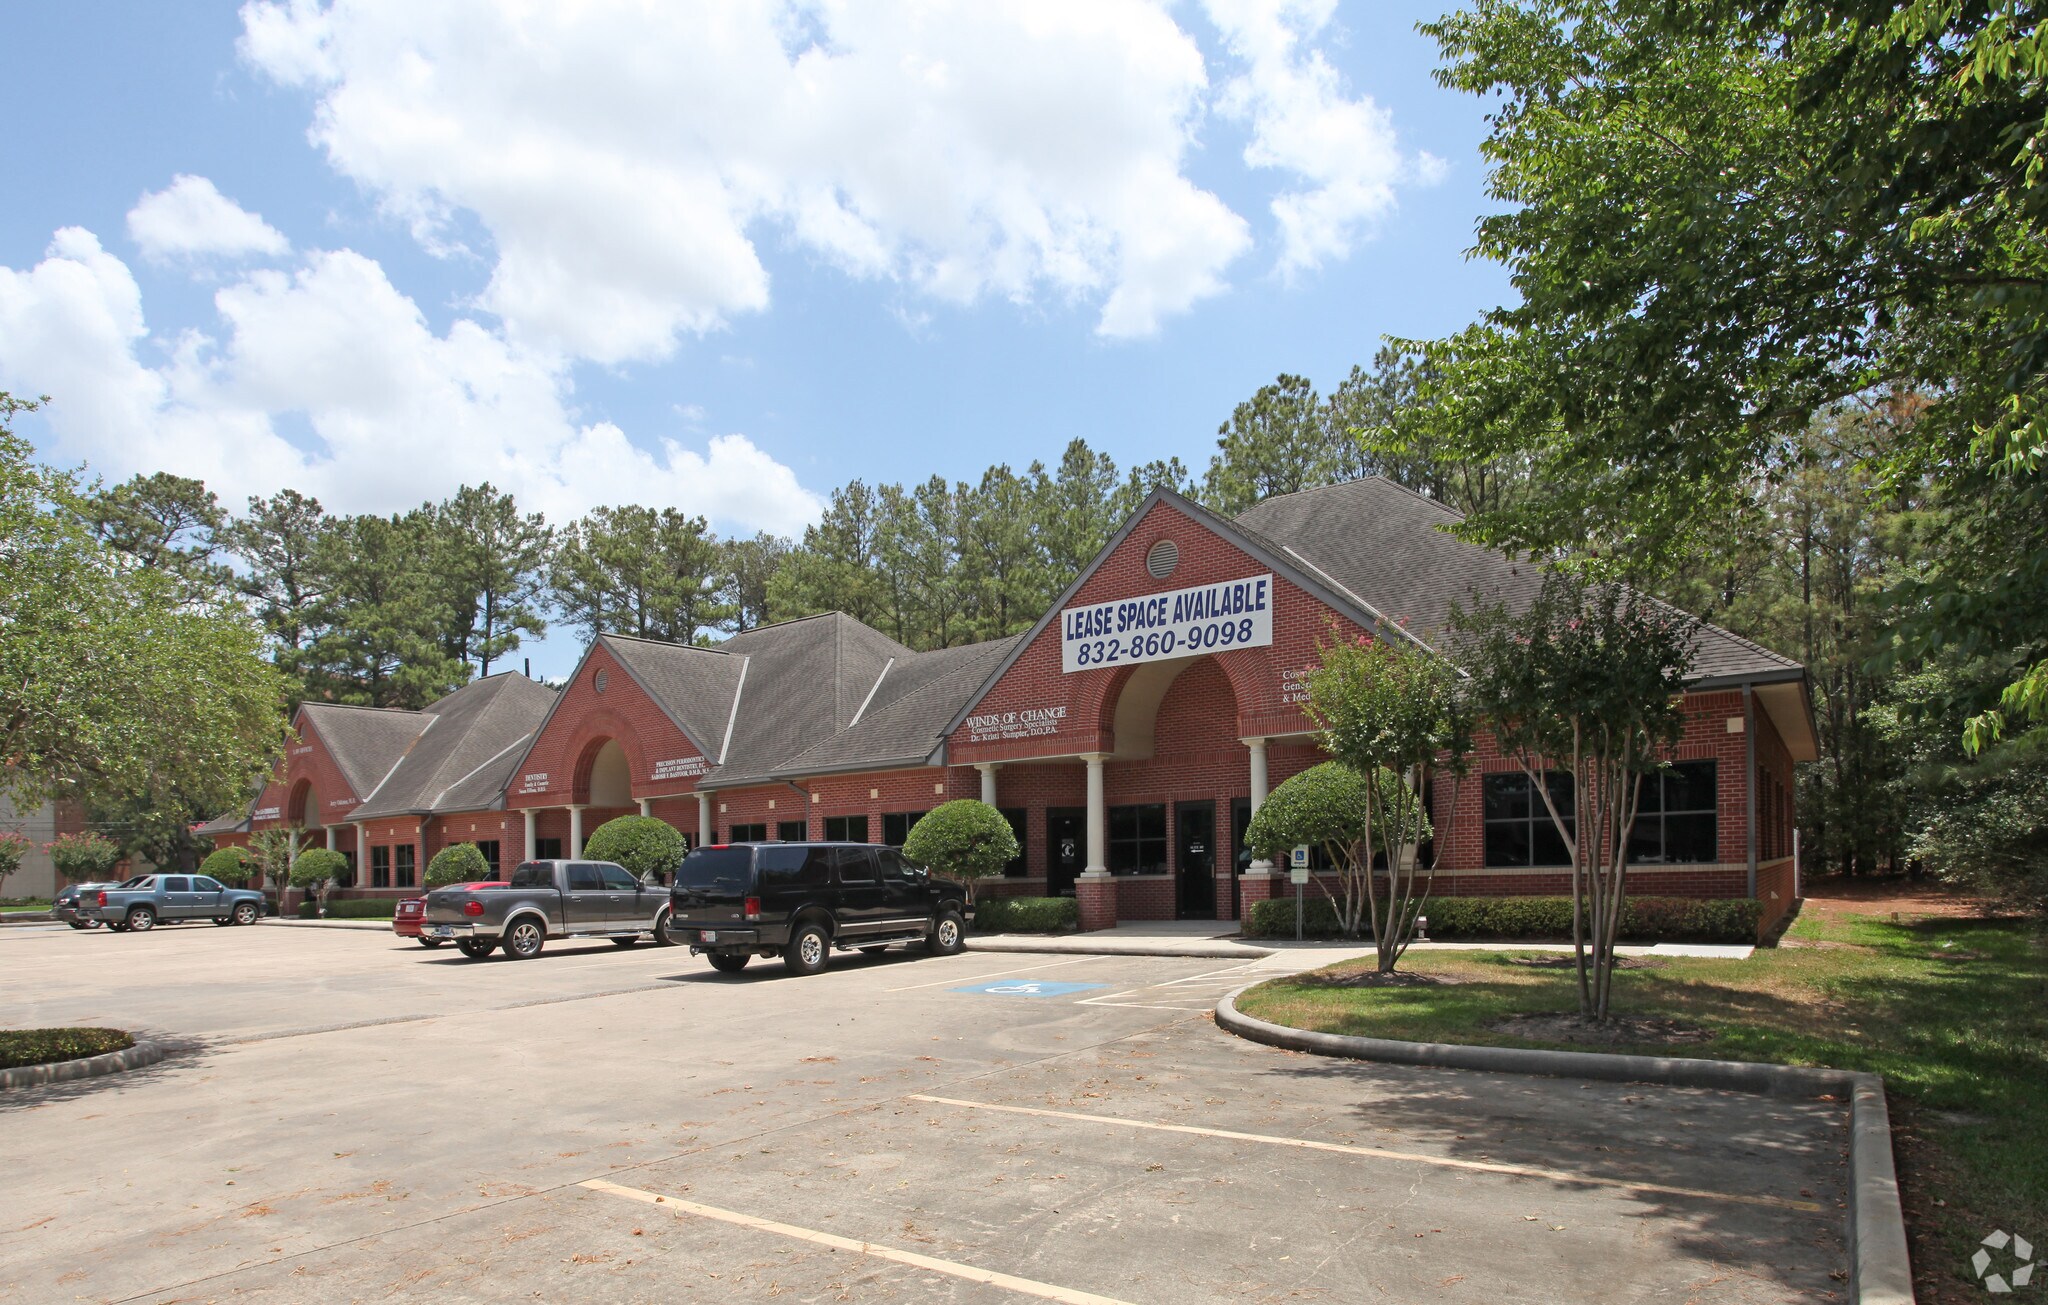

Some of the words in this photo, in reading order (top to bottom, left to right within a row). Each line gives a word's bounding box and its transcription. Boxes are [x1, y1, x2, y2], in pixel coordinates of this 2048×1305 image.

[1066, 606, 1114, 641] LEASE
[1117, 597, 1169, 633] SPACE
[1172, 580, 1267, 625] AVAILABLE
[1077, 618, 1254, 666] 832-860-9098
[1282, 694, 1290, 703] &
[966, 715, 999, 728] WINDS
[1003, 712, 1017, 724] OF
[1020, 706, 1067, 722] CHANGE
[971, 725, 999, 735] Cosmetic
[1000, 722, 1022, 732] Surgery
[1024, 718, 1058, 730] Specialists
